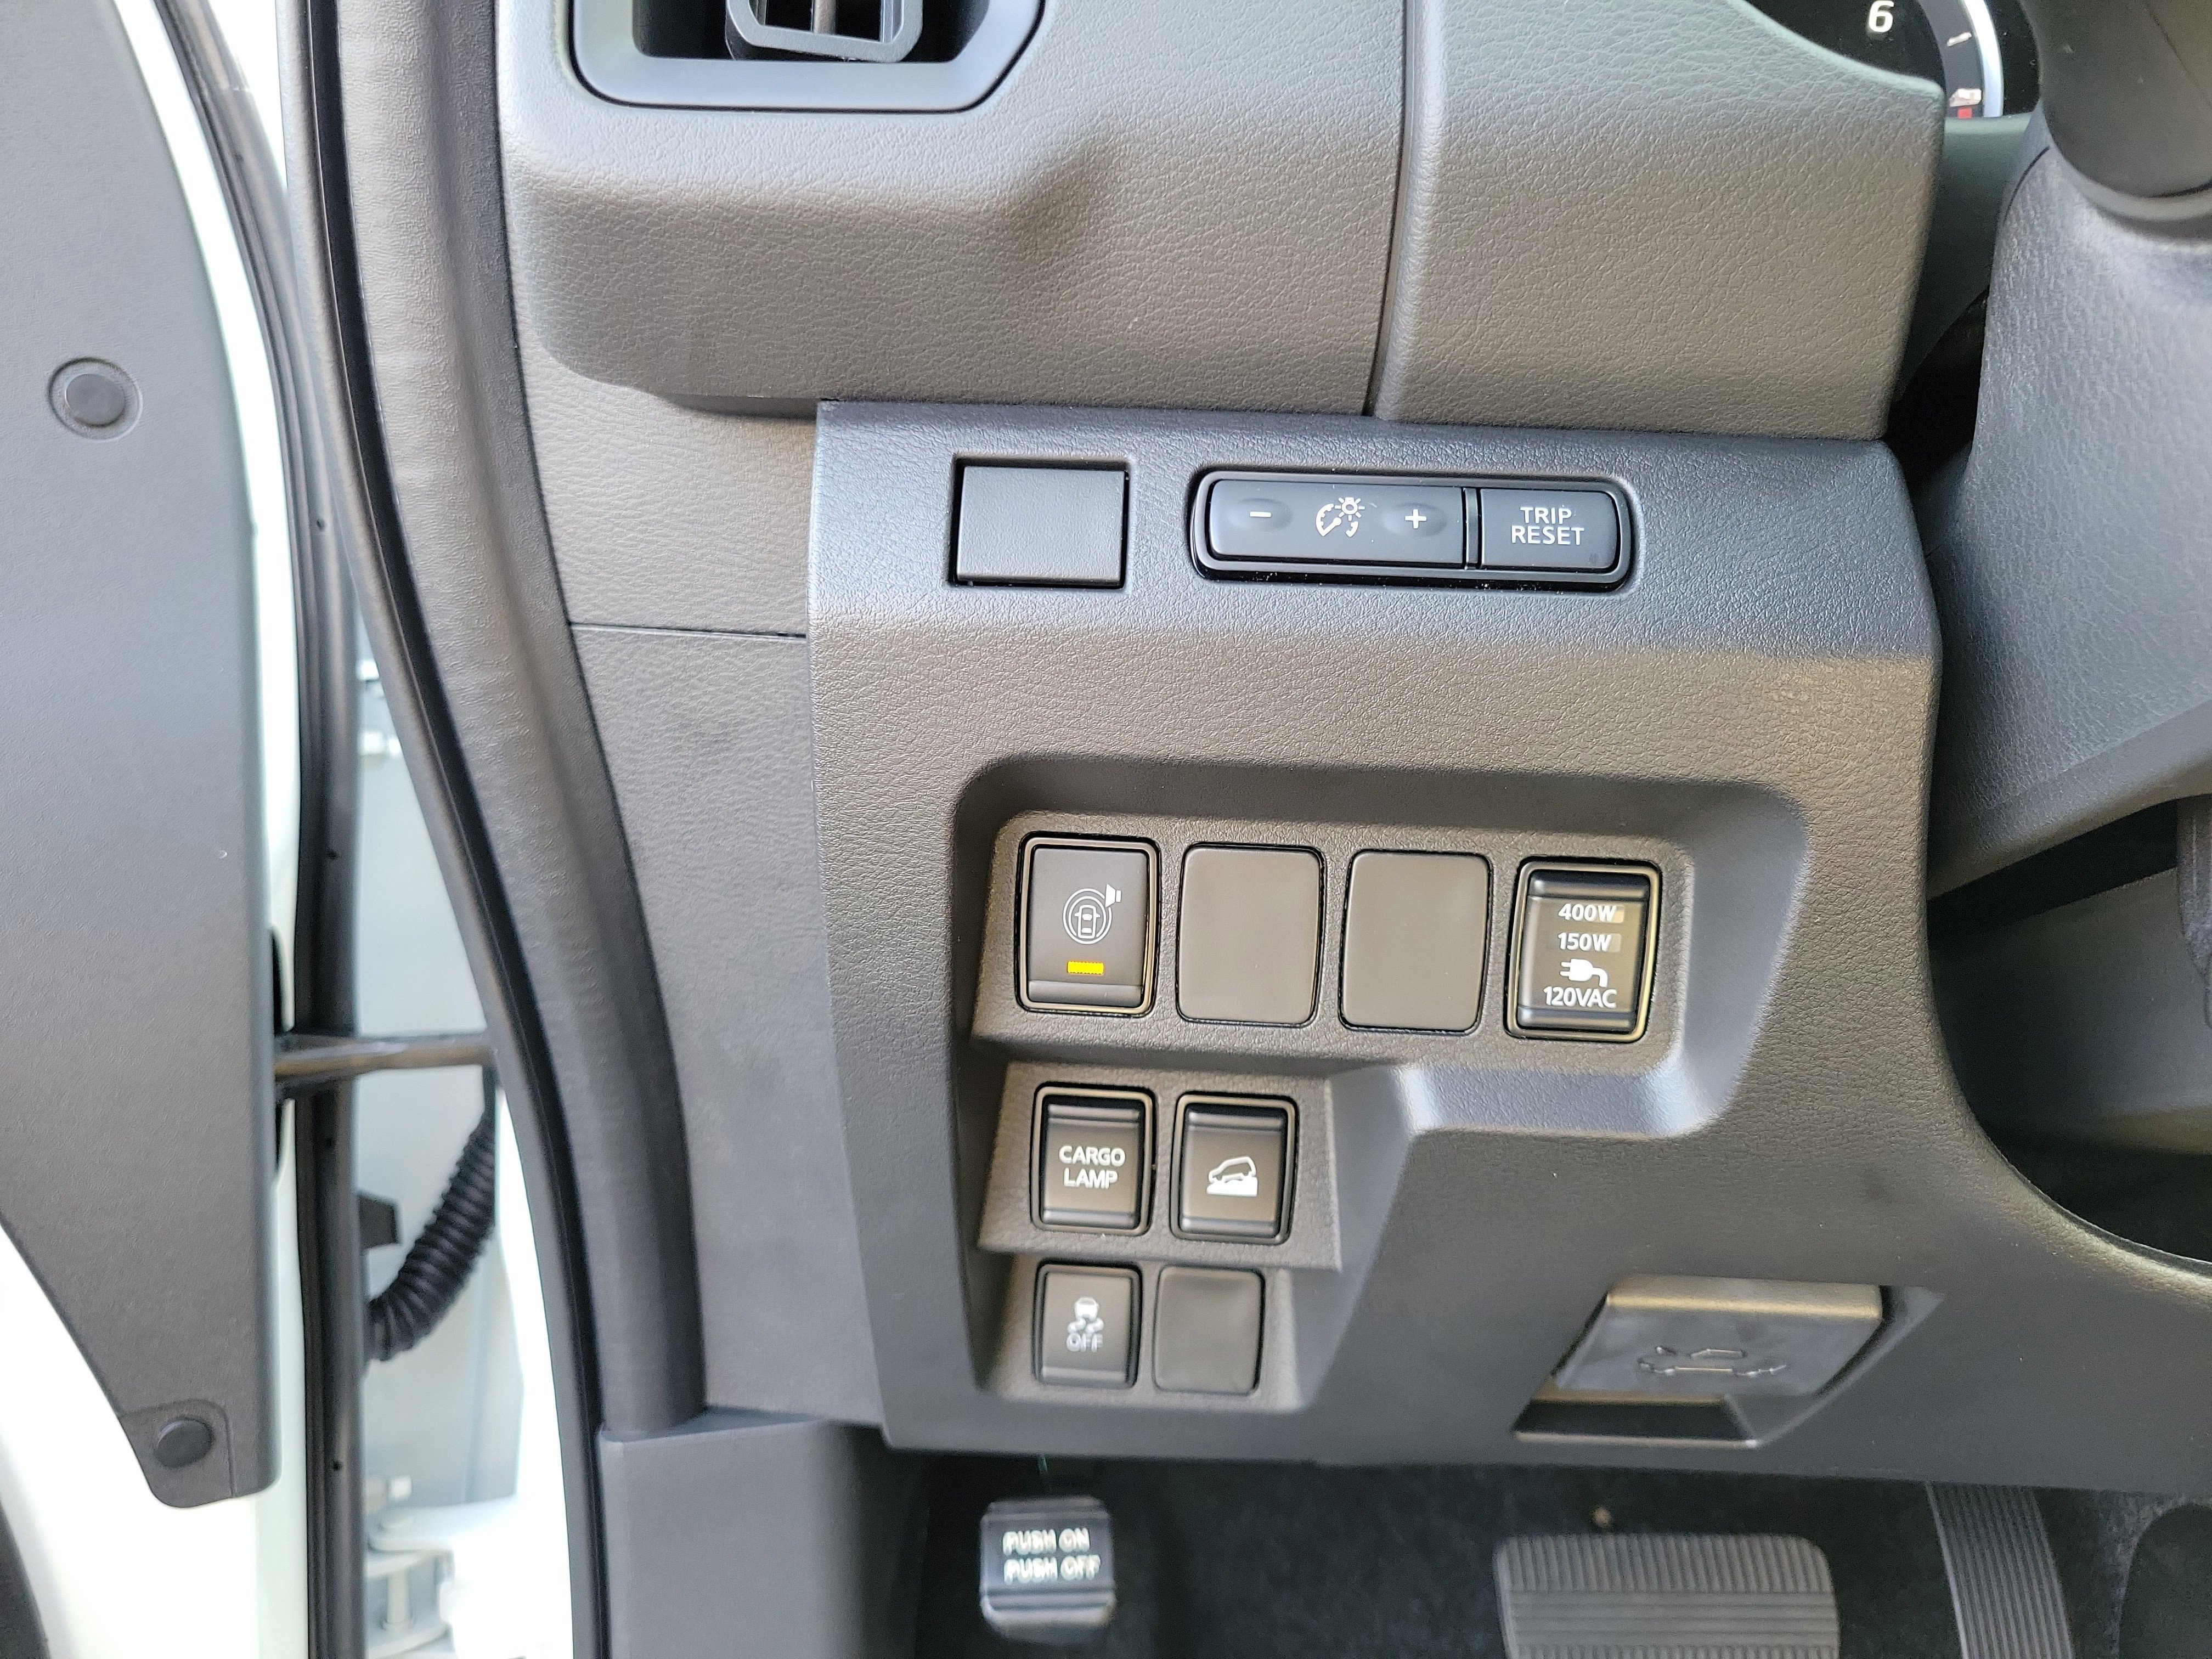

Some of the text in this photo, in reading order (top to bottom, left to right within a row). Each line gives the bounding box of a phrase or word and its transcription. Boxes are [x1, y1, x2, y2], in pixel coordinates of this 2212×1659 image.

[1869, 0, 1894, 32] 6
[1520, 506, 1572, 523] TRIP
[1511, 525, 1584, 546] RESET
[1558, 904, 1617, 922] 400W
[1558, 933, 1612, 951] 150W
[1543, 986, 1617, 1008] 120VAC
[1059, 1146, 1126, 1167] CARGO
[1063, 1169, 1118, 1189] LAMP
[1065, 1333, 1103, 1352] OFF
[1002, 1527, 1090, 1555] PUSH ON
[1003, 1555, 1101, 1585] PUSH OFF
